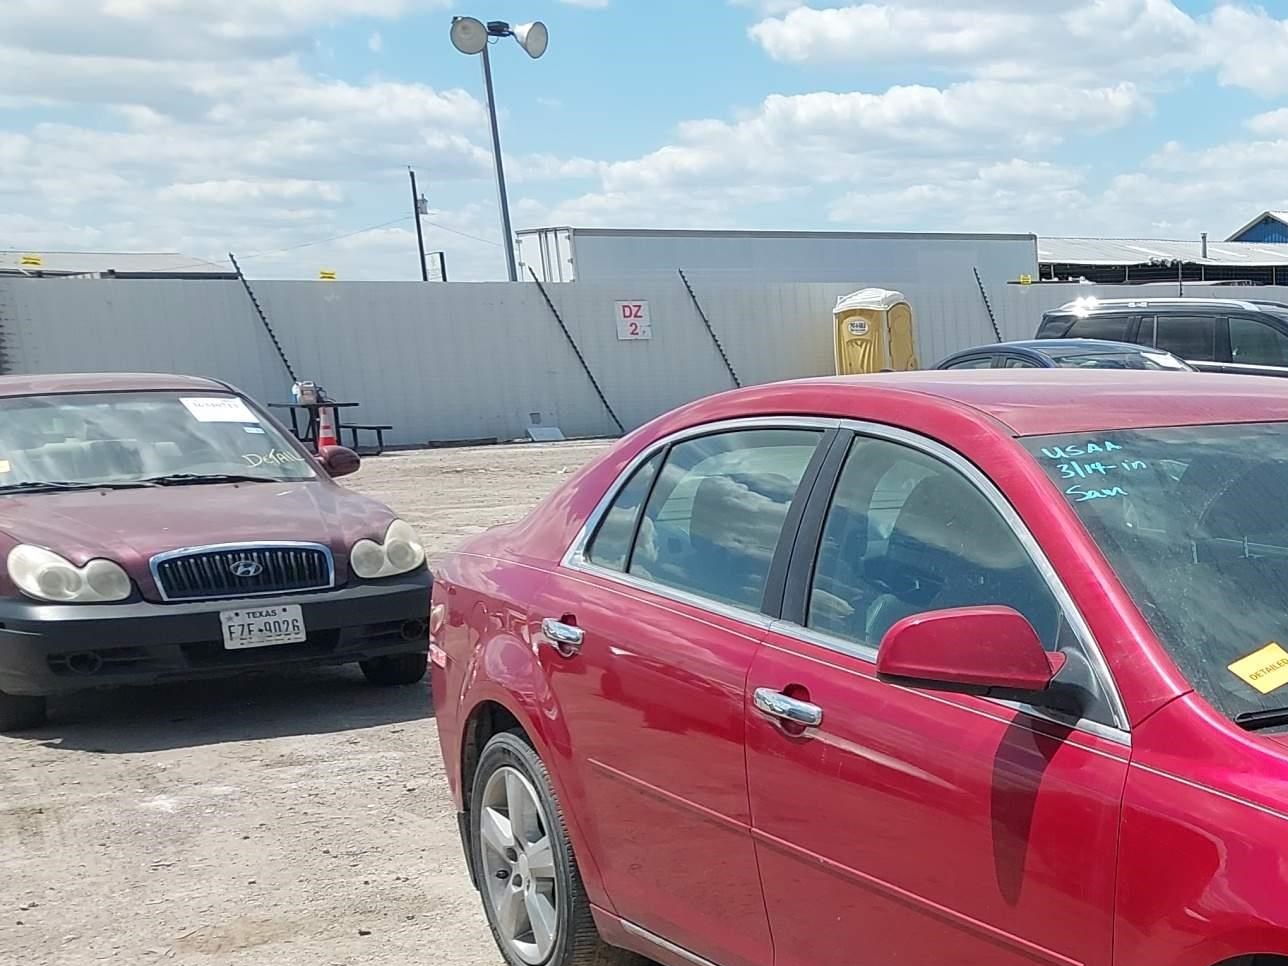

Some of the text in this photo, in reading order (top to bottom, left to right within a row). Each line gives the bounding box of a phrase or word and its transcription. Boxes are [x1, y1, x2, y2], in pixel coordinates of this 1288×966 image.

[622, 304, 643, 319] DZ
[629, 322, 640, 336] 2
[1041, 441, 1123, 459] USAA
[246, 609, 278, 619] TEXAS
